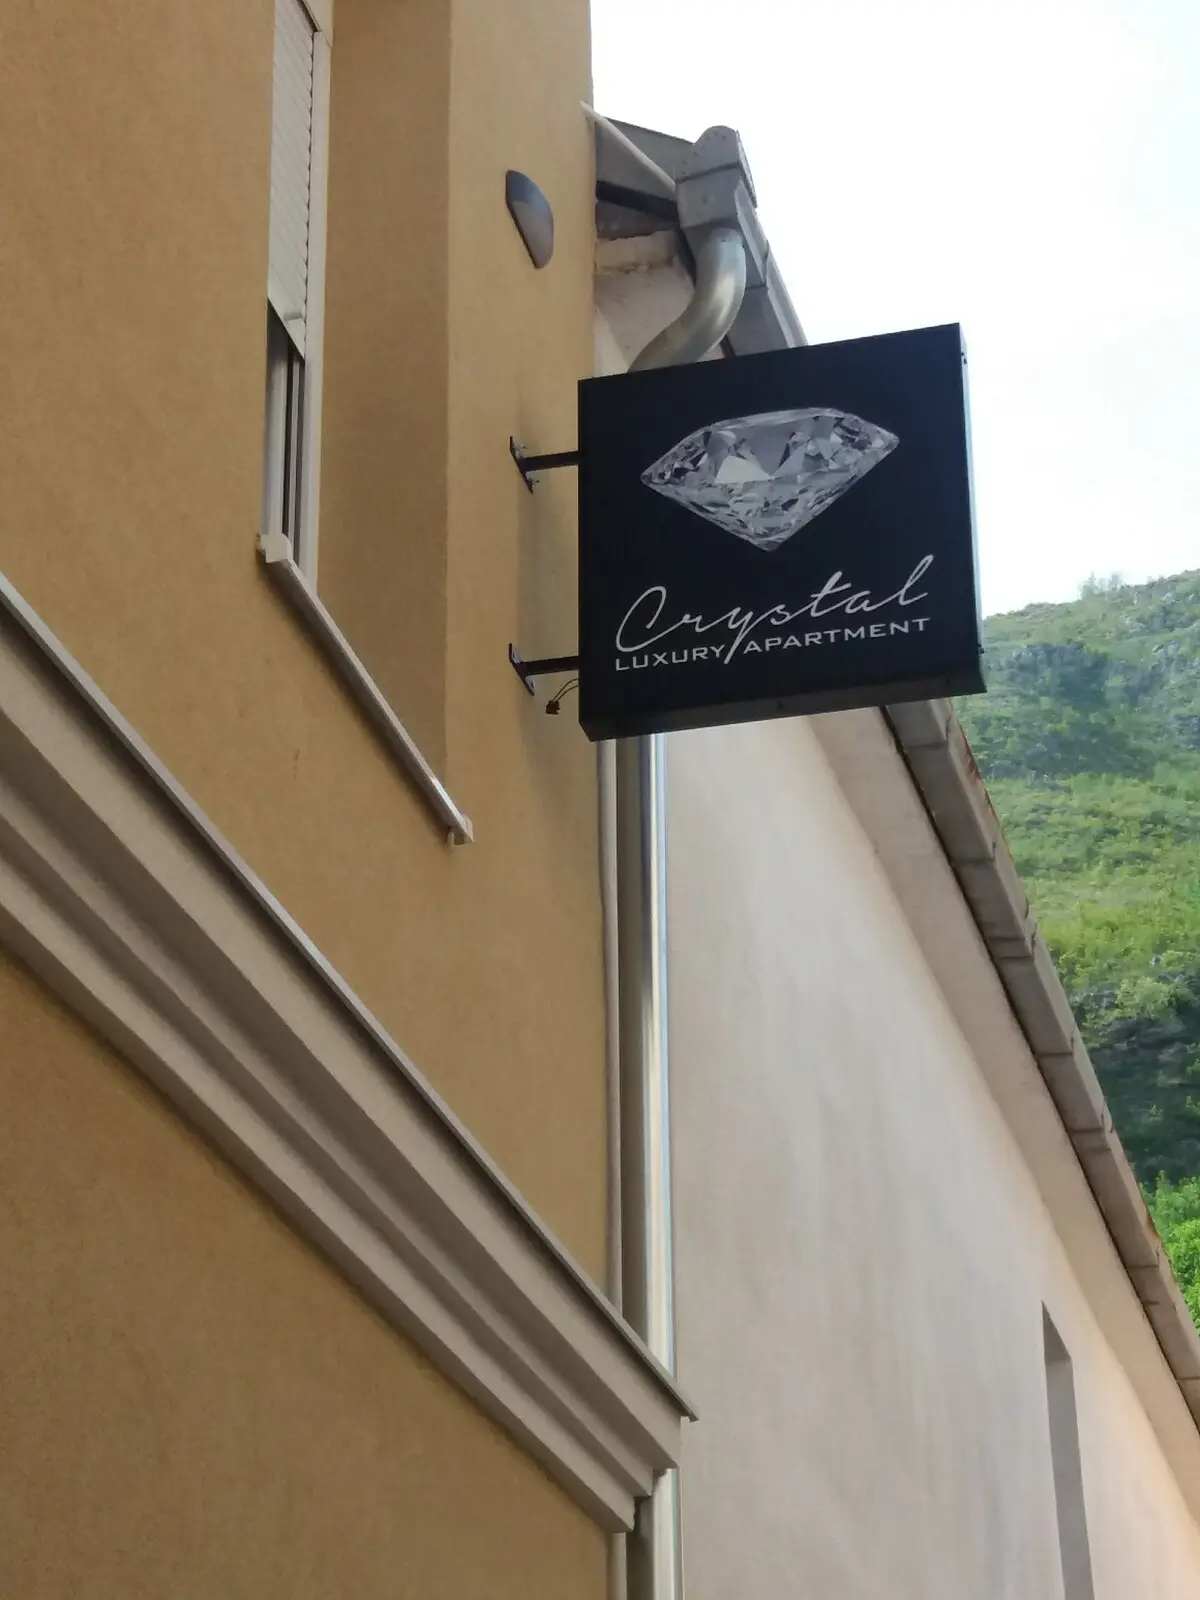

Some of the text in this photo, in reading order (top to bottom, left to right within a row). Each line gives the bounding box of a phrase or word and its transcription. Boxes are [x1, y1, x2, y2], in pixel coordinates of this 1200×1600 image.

[614, 617, 931, 672] LUXURY APARTMENT
[615, 554, 934, 665] Crystal
